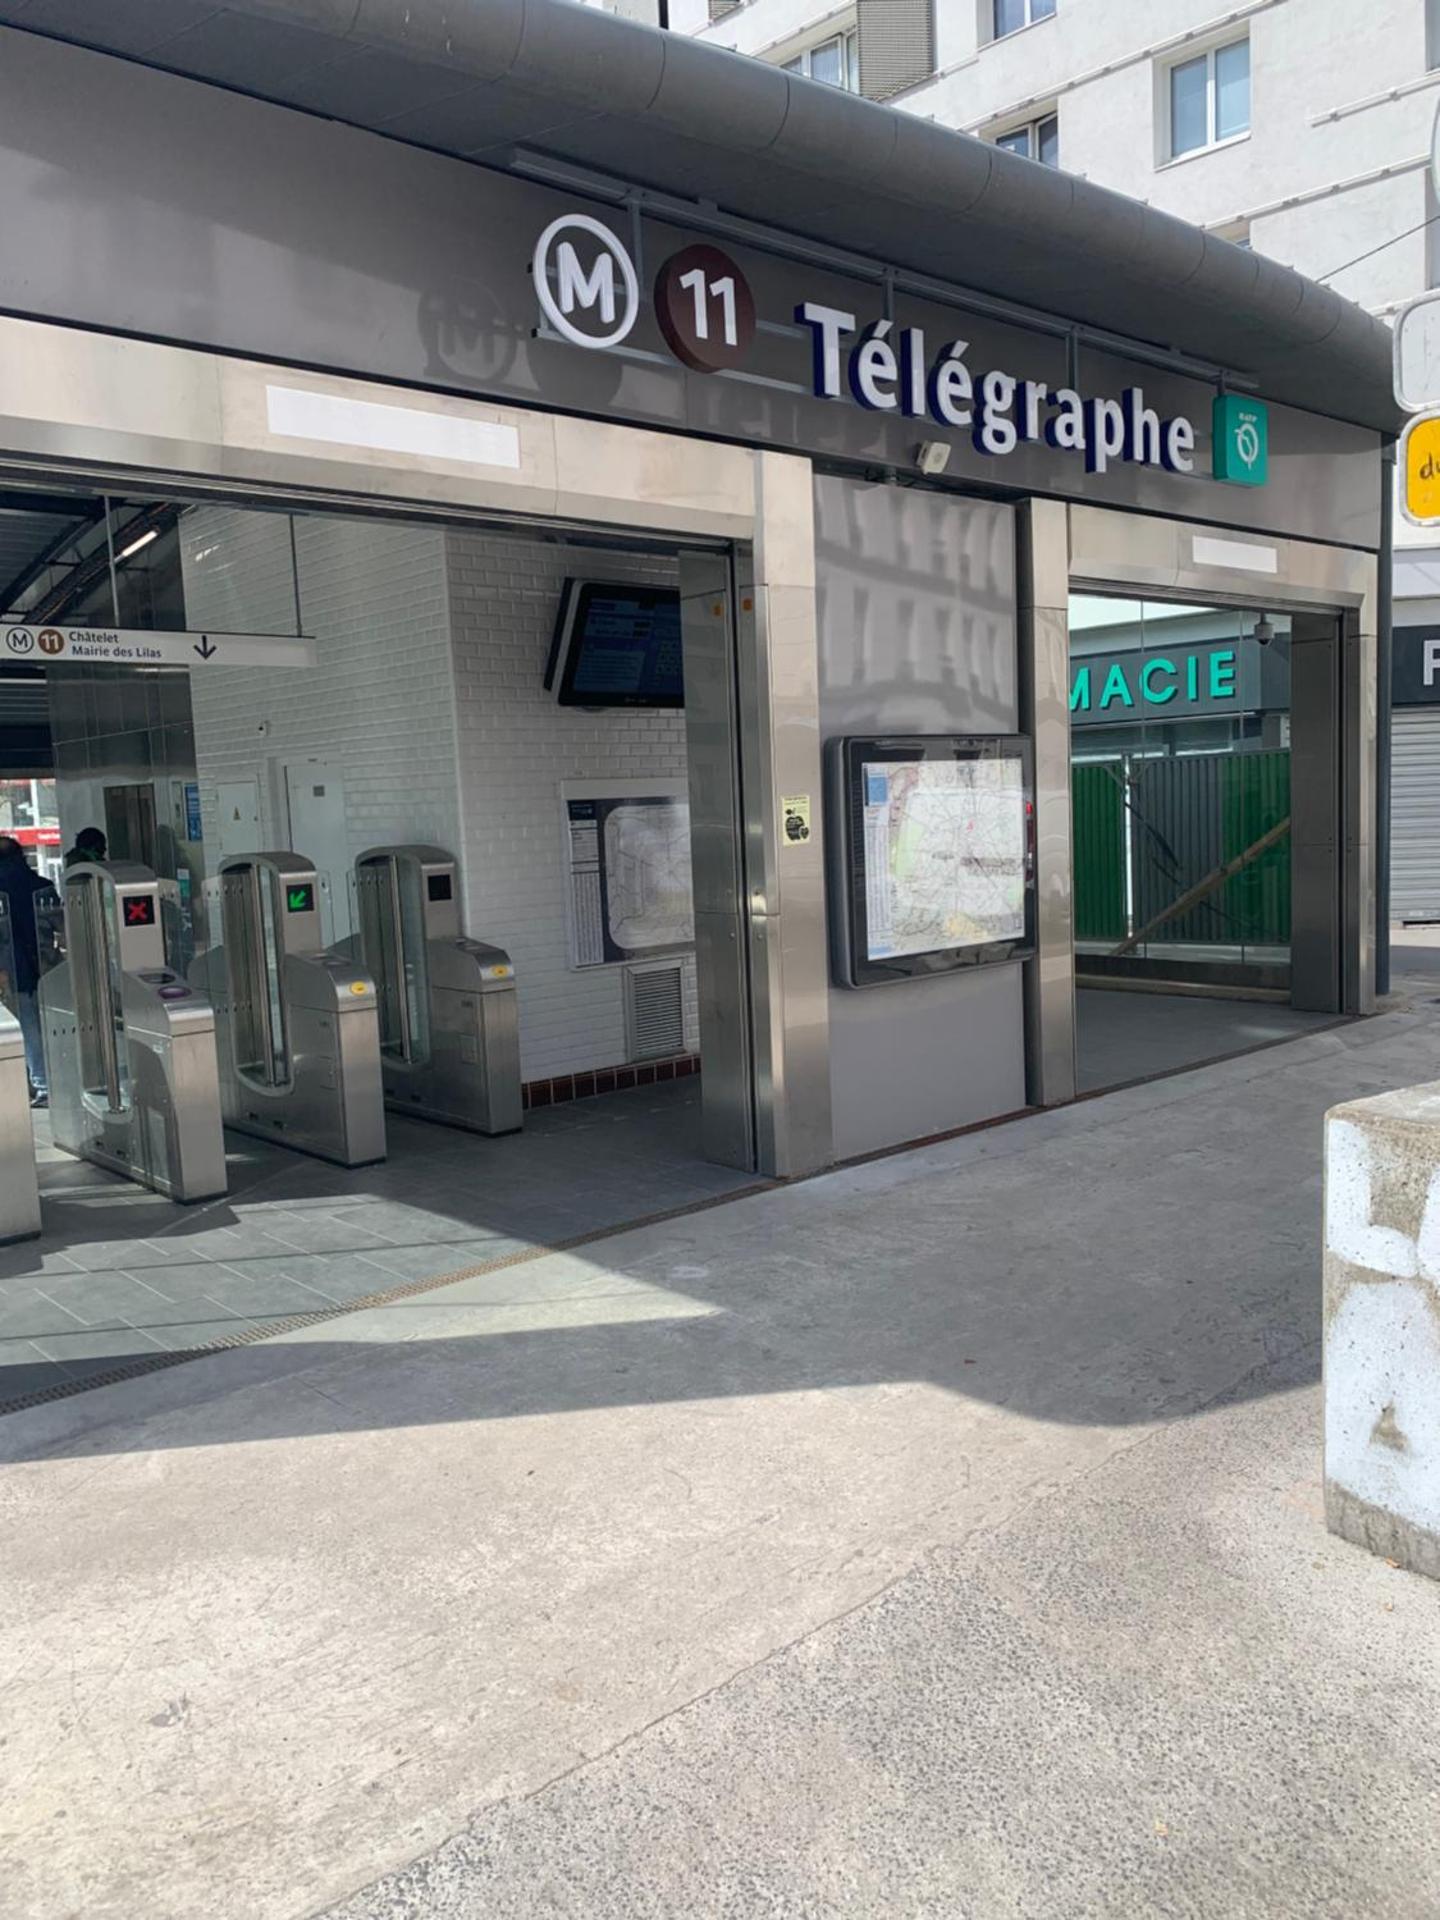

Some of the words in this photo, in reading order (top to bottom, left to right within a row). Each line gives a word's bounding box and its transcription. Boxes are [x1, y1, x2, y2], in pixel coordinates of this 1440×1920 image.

[556, 240, 617, 325] M
[679, 267, 740, 347] 11
[796, 302, 1196, 475] Télégraphe
[12, 634, 28, 648] M
[40, 634, 60, 650] 11
[69, 631, 119, 644] Châtelet
[71, 646, 110, 656] Mairie
[113, 647, 133, 657] des
[136, 648, 162, 658] Lilas
